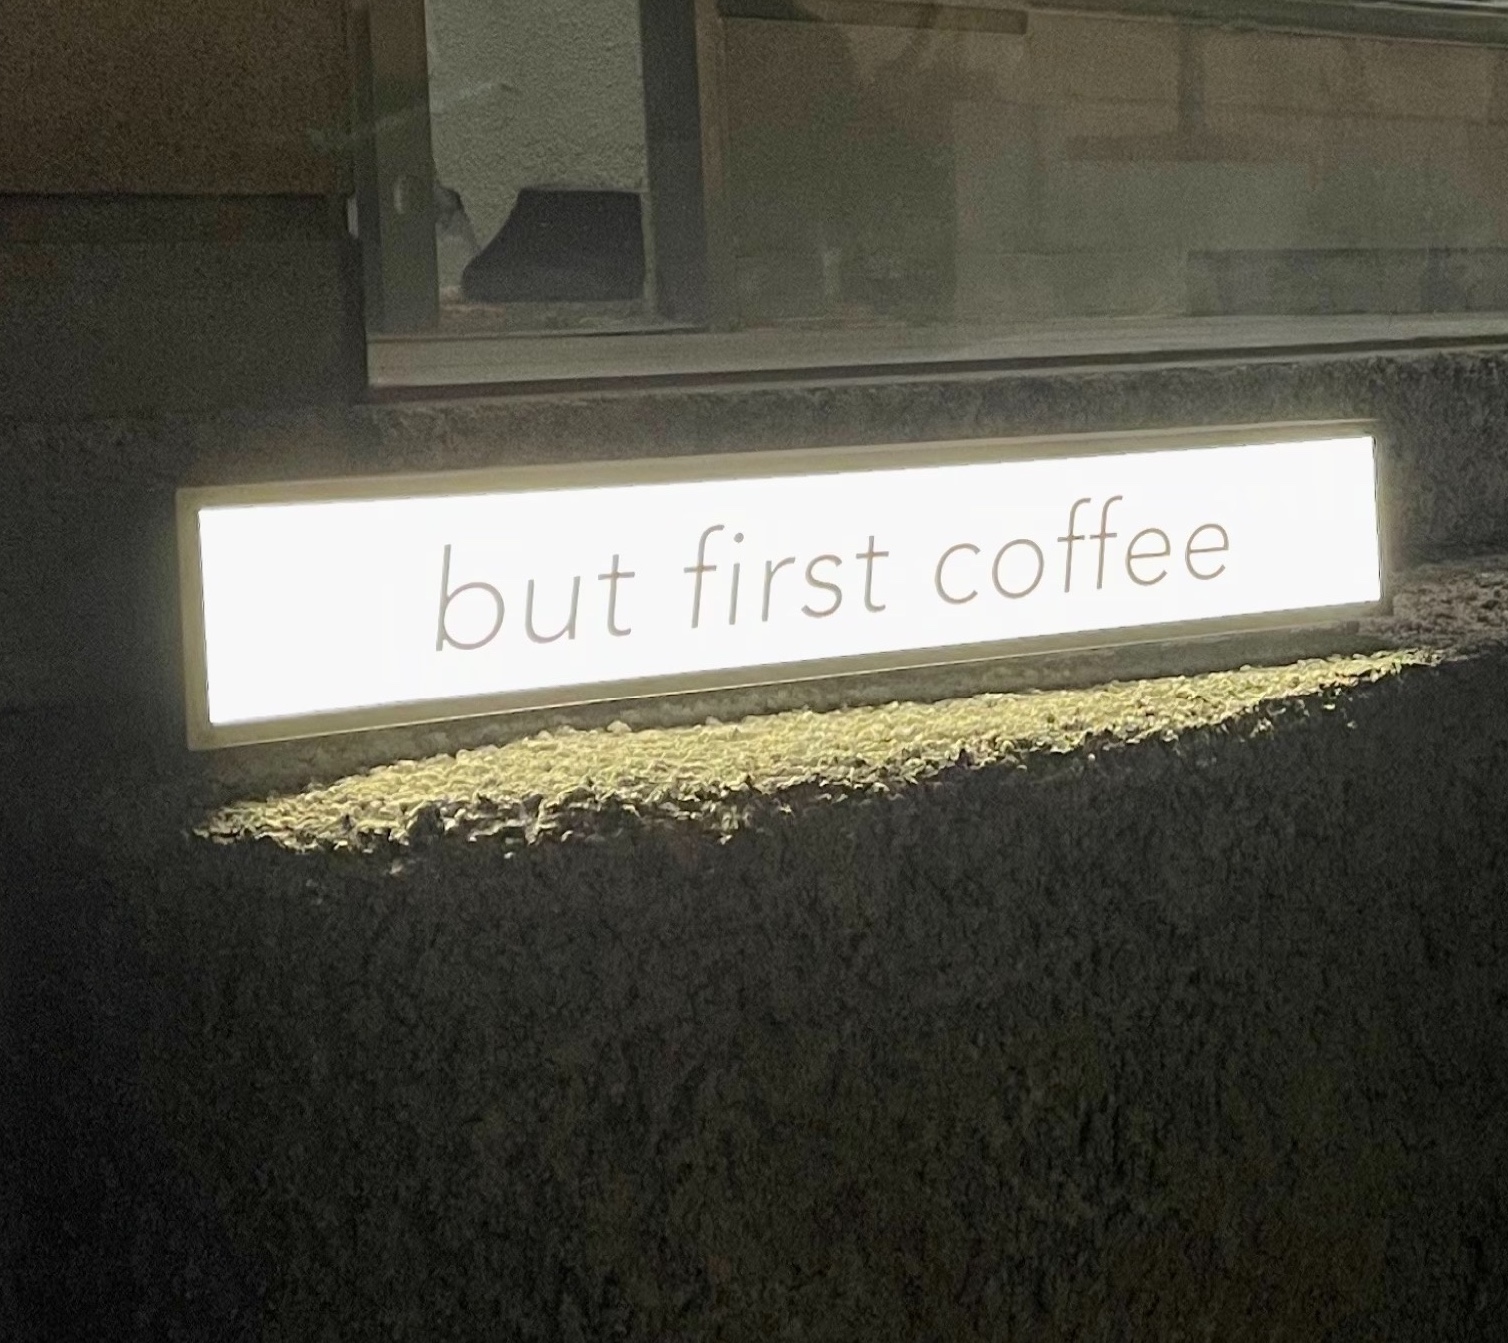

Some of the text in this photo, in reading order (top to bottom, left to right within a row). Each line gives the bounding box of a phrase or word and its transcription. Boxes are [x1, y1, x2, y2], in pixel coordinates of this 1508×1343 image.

[434, 494, 1231, 653] but first coffee
